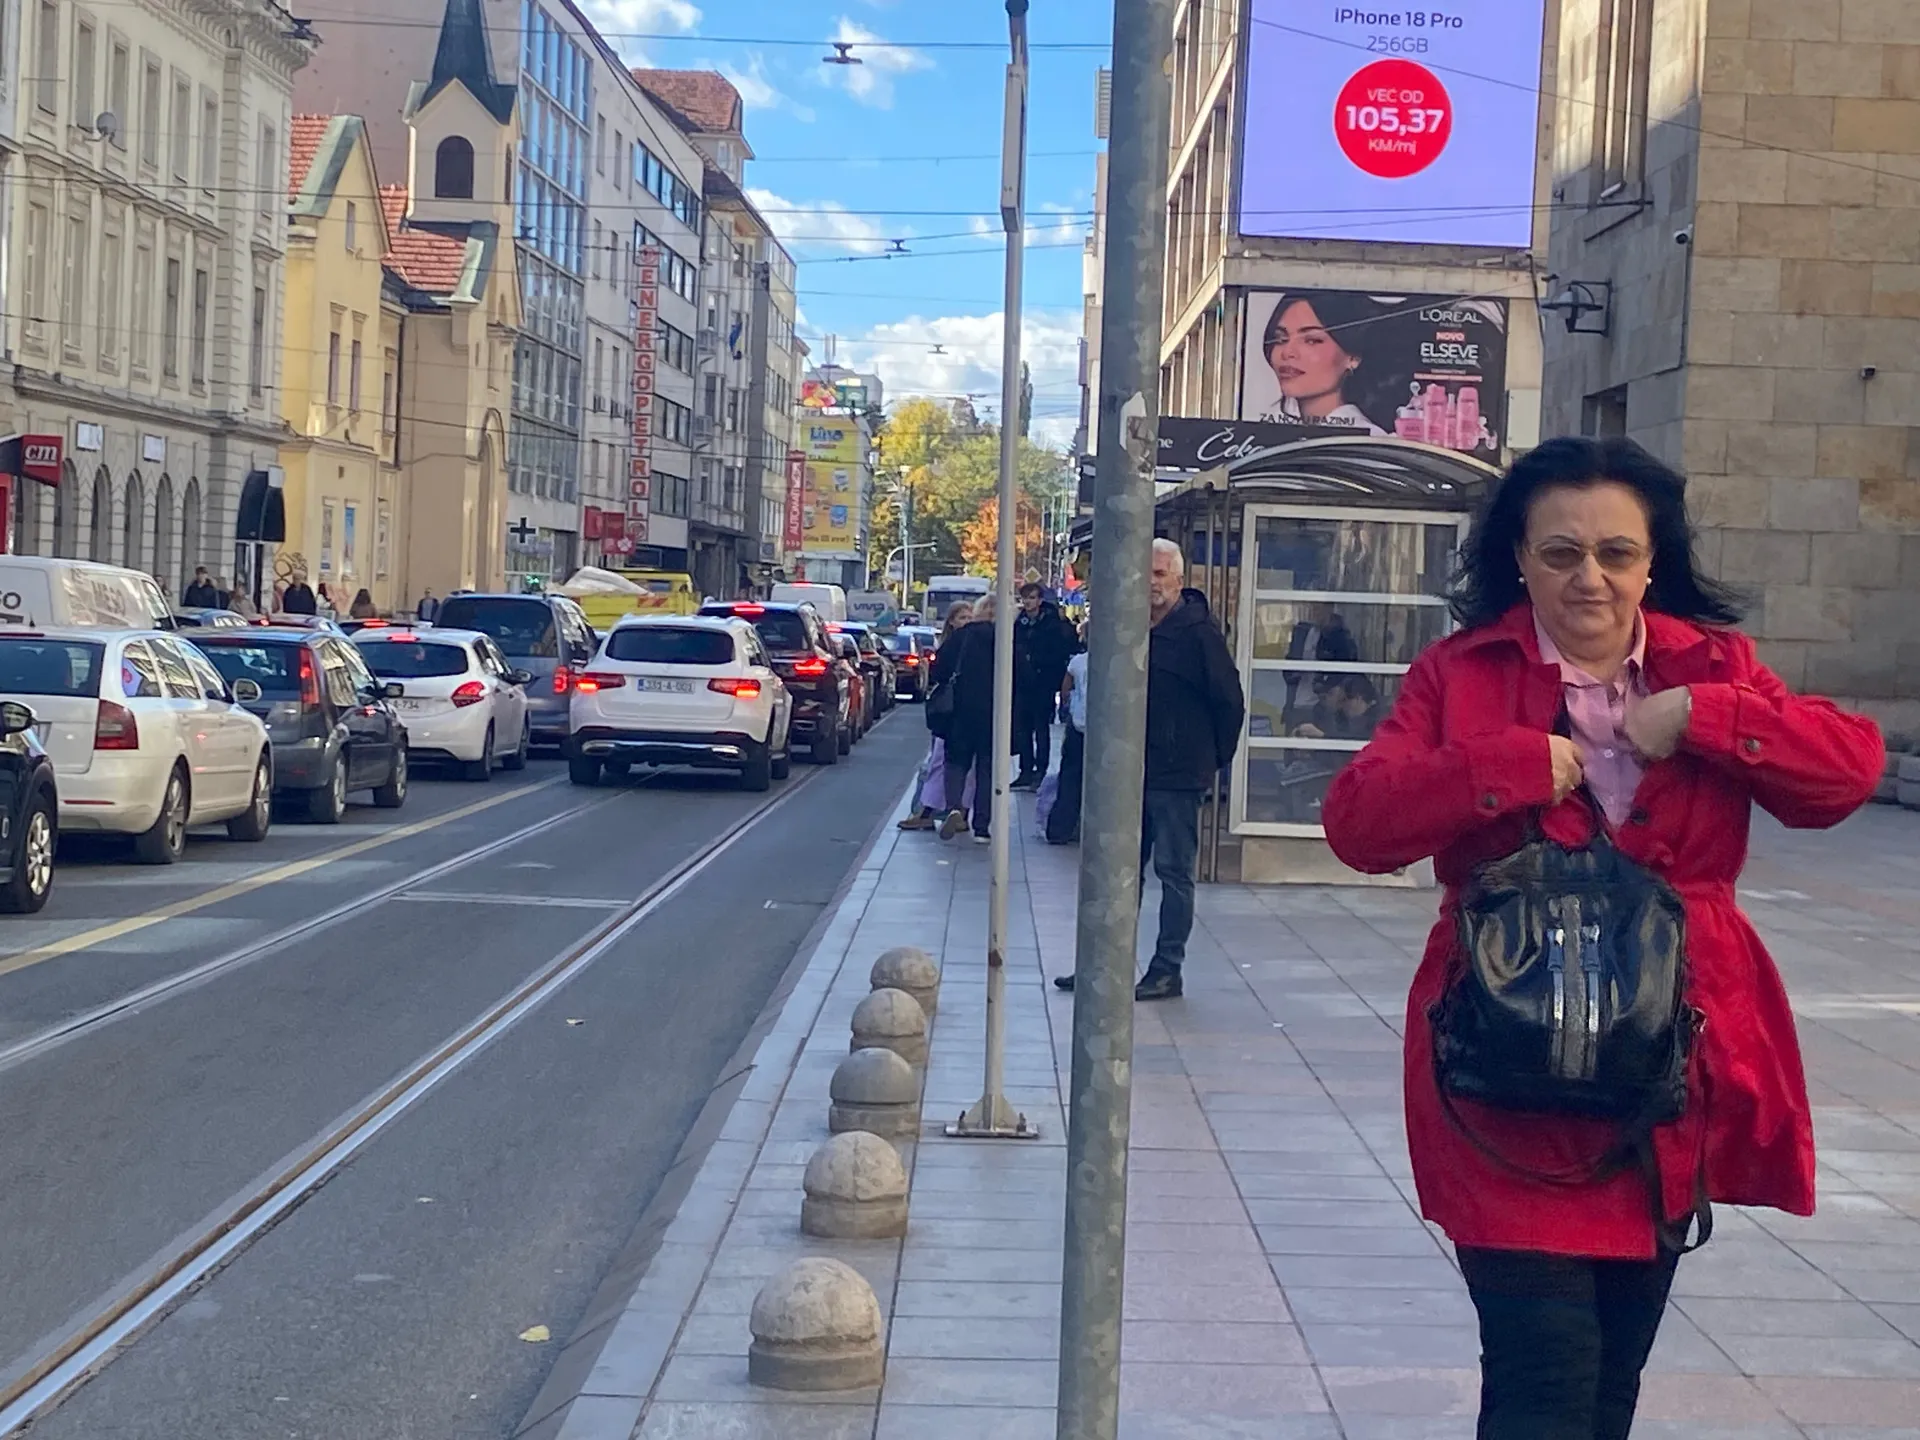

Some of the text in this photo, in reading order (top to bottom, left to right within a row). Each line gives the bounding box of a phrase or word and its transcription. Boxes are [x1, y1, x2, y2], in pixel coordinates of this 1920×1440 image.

[1334, 7, 1463, 28] iPhone 18 Pro
[1366, 35, 1429, 53] 256GB
[1400, 90, 1424, 104] OD
[1346, 105, 1445, 136] 105,37
[1368, 138, 1416, 155] KM/mj
[1420, 342, 1479, 359] ELSEVE
[631, 268, 655, 519] ENERGOPETROL
[24, 444, 57, 461] cm
